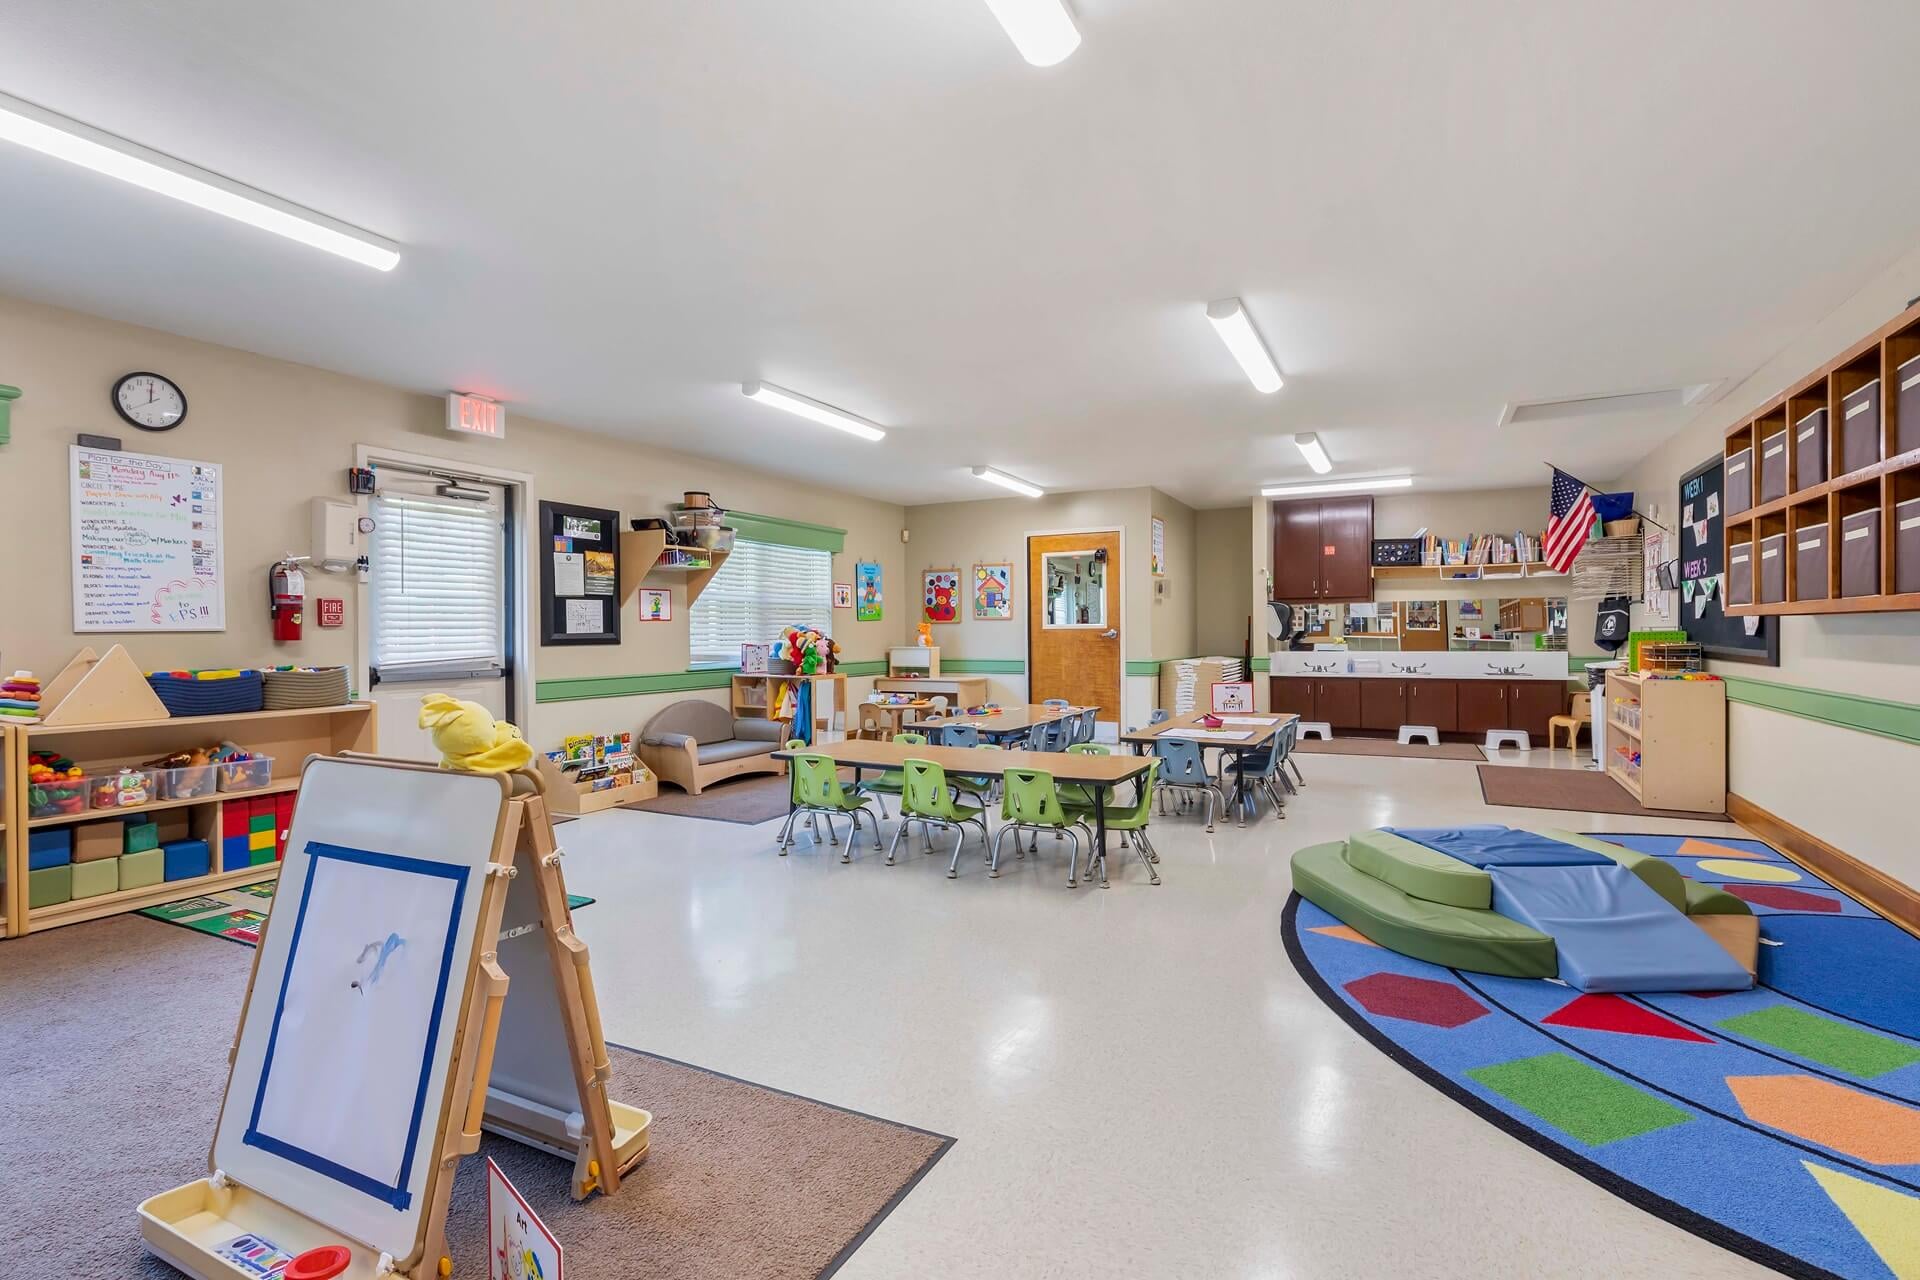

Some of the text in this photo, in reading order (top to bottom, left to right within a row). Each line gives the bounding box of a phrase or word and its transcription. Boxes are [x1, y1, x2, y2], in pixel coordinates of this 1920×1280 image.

[460, 399, 496, 433] EXIT
[88, 453, 108, 462] Plan
[112, 465, 145, 480] Monday
[149, 470, 165, 480] Aug
[1684, 477, 1700, 500] WEEK
[82, 534, 109, 542] Making
[1684, 557, 1707, 578] WEEK 3
[324, 602, 342, 612] FIRE
[516, 1210, 528, 1235] Art
